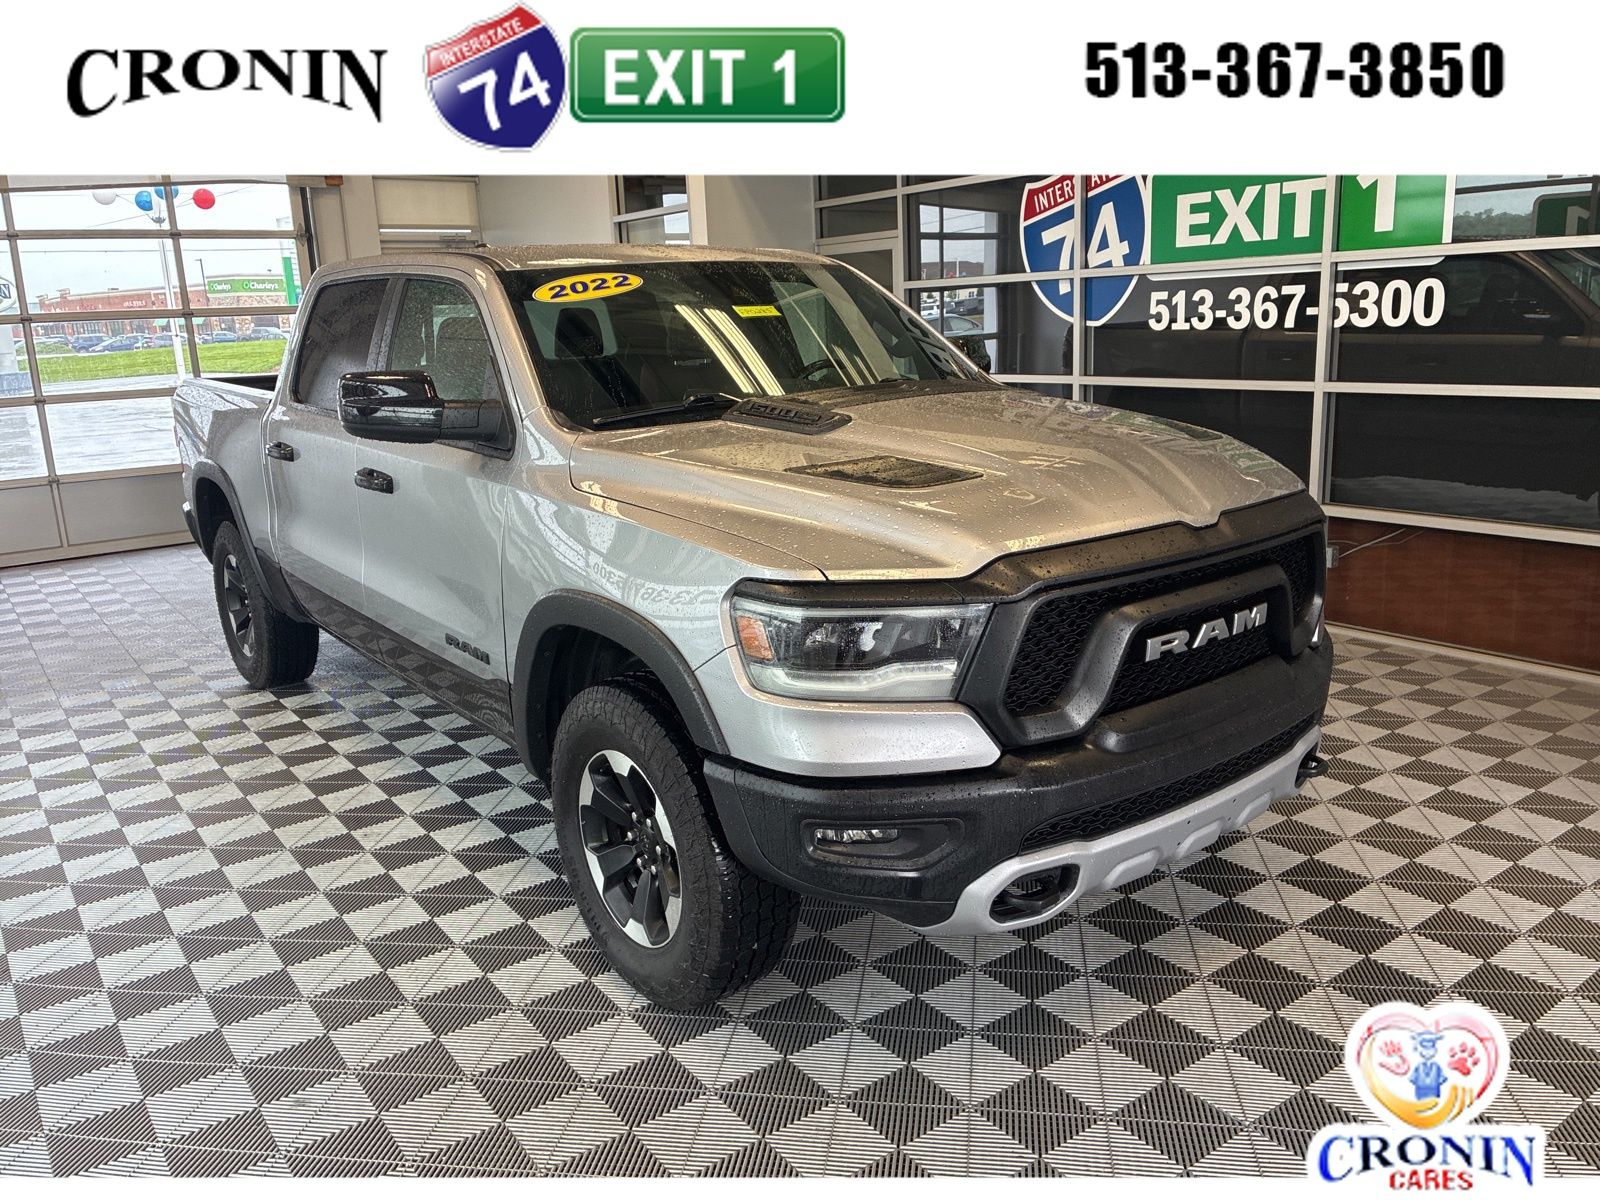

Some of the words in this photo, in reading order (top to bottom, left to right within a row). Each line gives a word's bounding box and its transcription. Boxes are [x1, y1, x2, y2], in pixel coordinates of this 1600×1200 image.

[1175, 177, 1327, 249] EXIT
[1356, 174, 1398, 233] 1
[1041, 201, 1130, 296] 74
[547, 275, 632, 299] 2022
[1148, 277, 1446, 332] 513-367-5300
[445, 632, 491, 666] RAM
[1145, 602, 1268, 663] RAM
